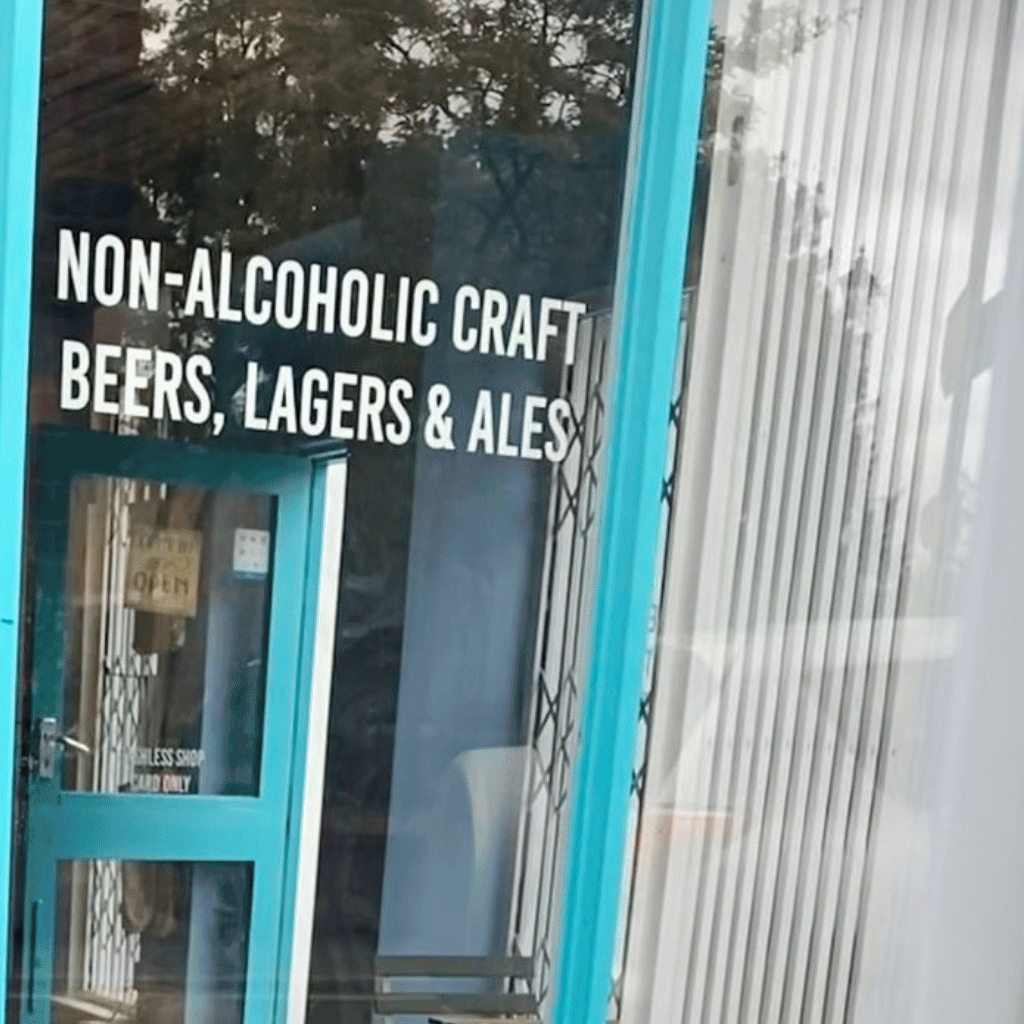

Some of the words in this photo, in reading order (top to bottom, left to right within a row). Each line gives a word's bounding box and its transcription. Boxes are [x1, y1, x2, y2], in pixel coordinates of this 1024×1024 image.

[57, 229, 439, 347] NON-ALCOHOLIC
[452, 284, 586, 364] CRAFT
[60, 339, 225, 436] BEERS,
[244, 361, 414, 446] LAGERS
[424, 383, 455, 450] &
[467, 389, 571, 463] ALES
